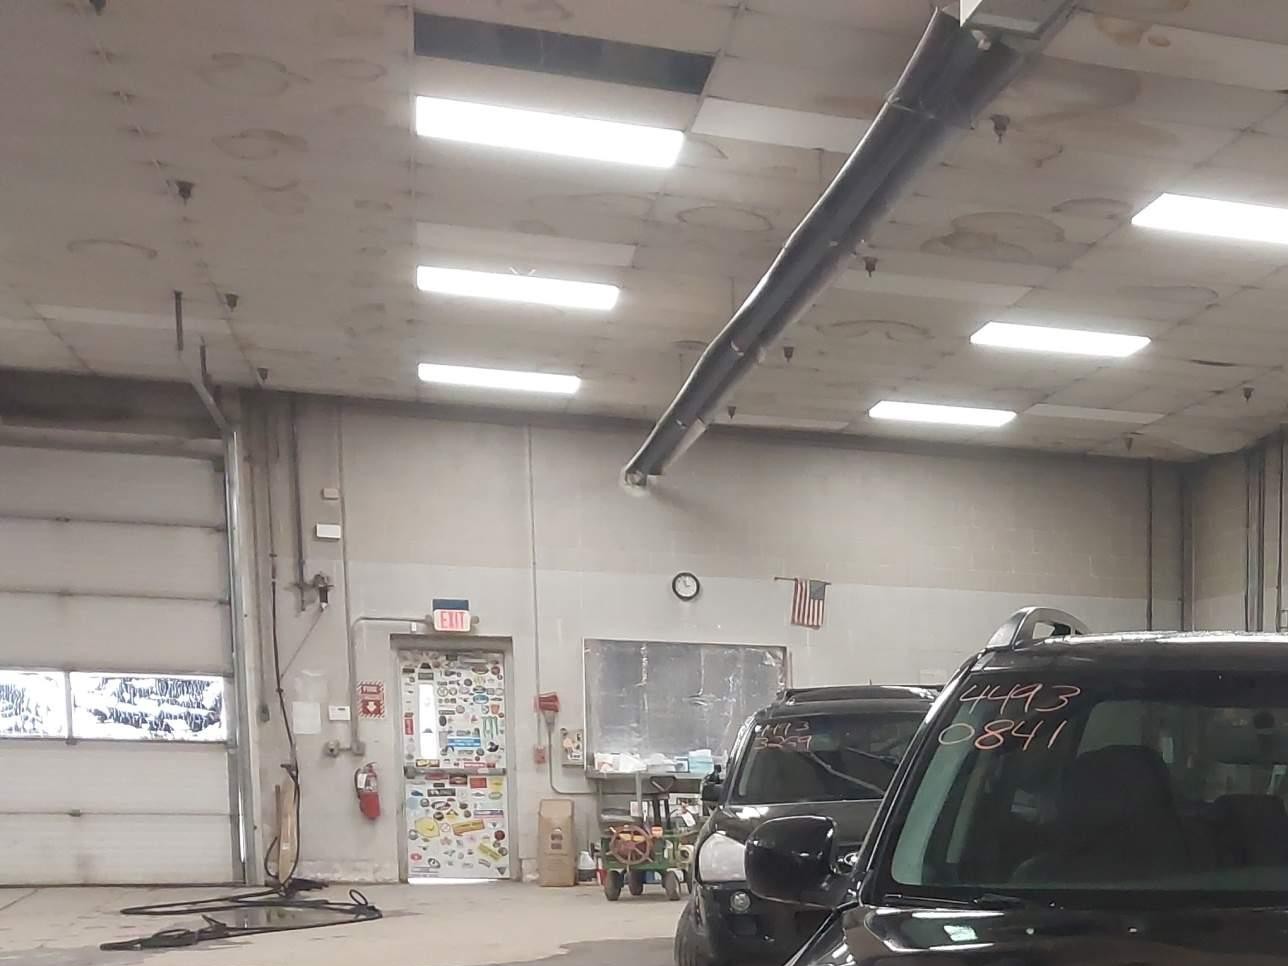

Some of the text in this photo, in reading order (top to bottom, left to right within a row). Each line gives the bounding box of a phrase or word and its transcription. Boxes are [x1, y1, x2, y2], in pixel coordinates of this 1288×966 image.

[440, 611, 464, 628] EXIT
[959, 683, 1081, 715] 4493
[938, 719, 1067, 751] 0841
